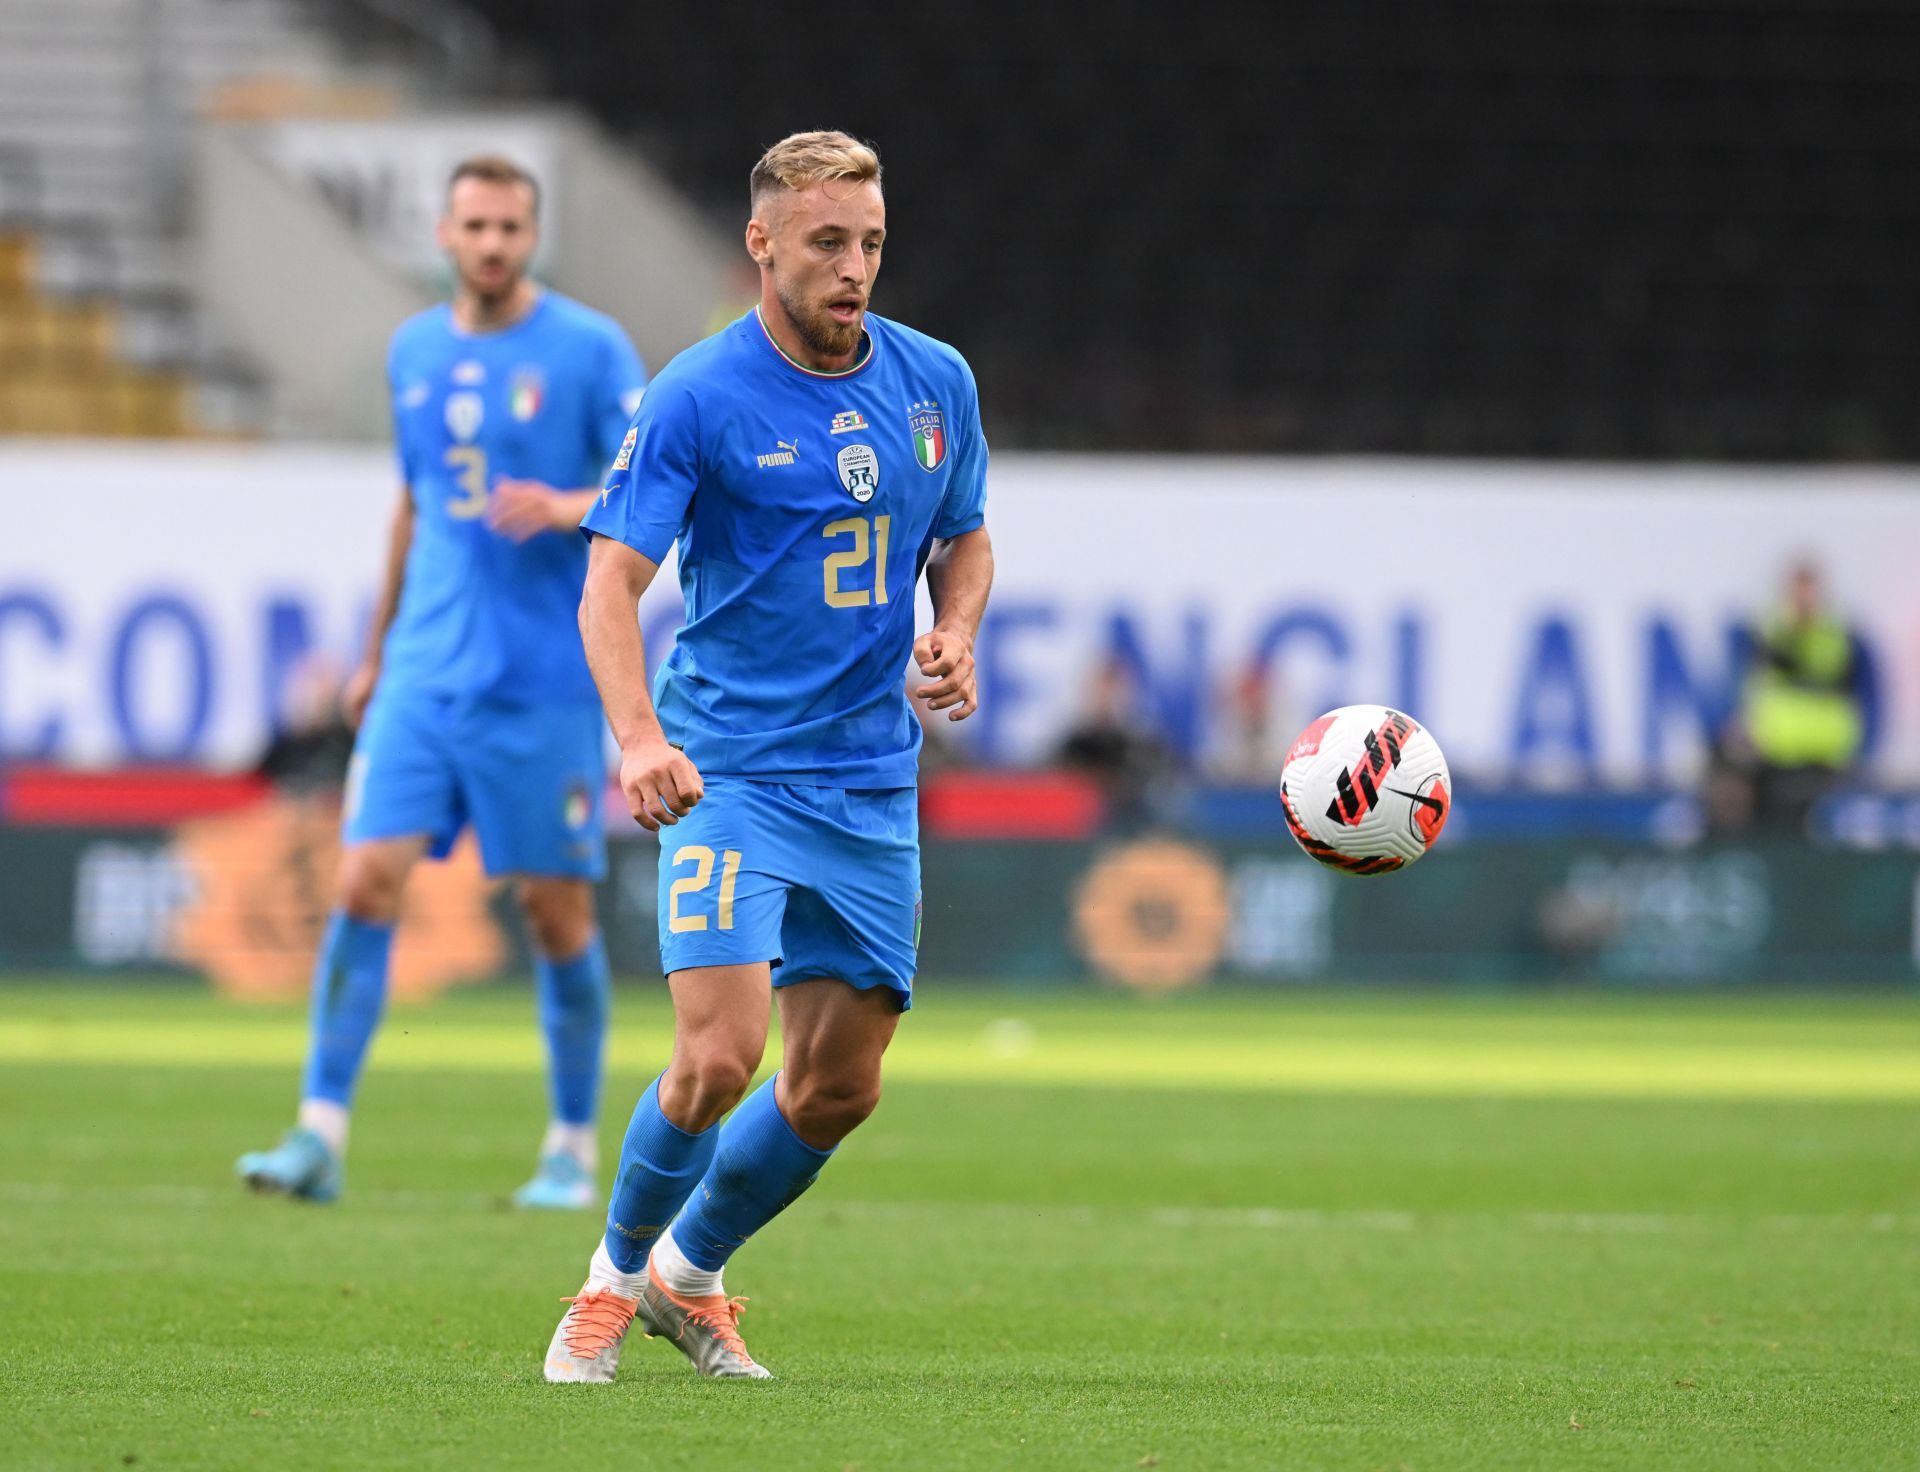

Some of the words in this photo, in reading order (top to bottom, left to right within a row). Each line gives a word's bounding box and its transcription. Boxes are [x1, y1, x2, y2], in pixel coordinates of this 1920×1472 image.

[911, 415, 940, 429] ITALIA
[757, 452, 794, 469] PUMA
[843, 454, 870, 462] EUROPEAN
[446, 447, 486, 519] 3
[823, 514, 891, 608] 21
[669, 845, 742, 934] 21
